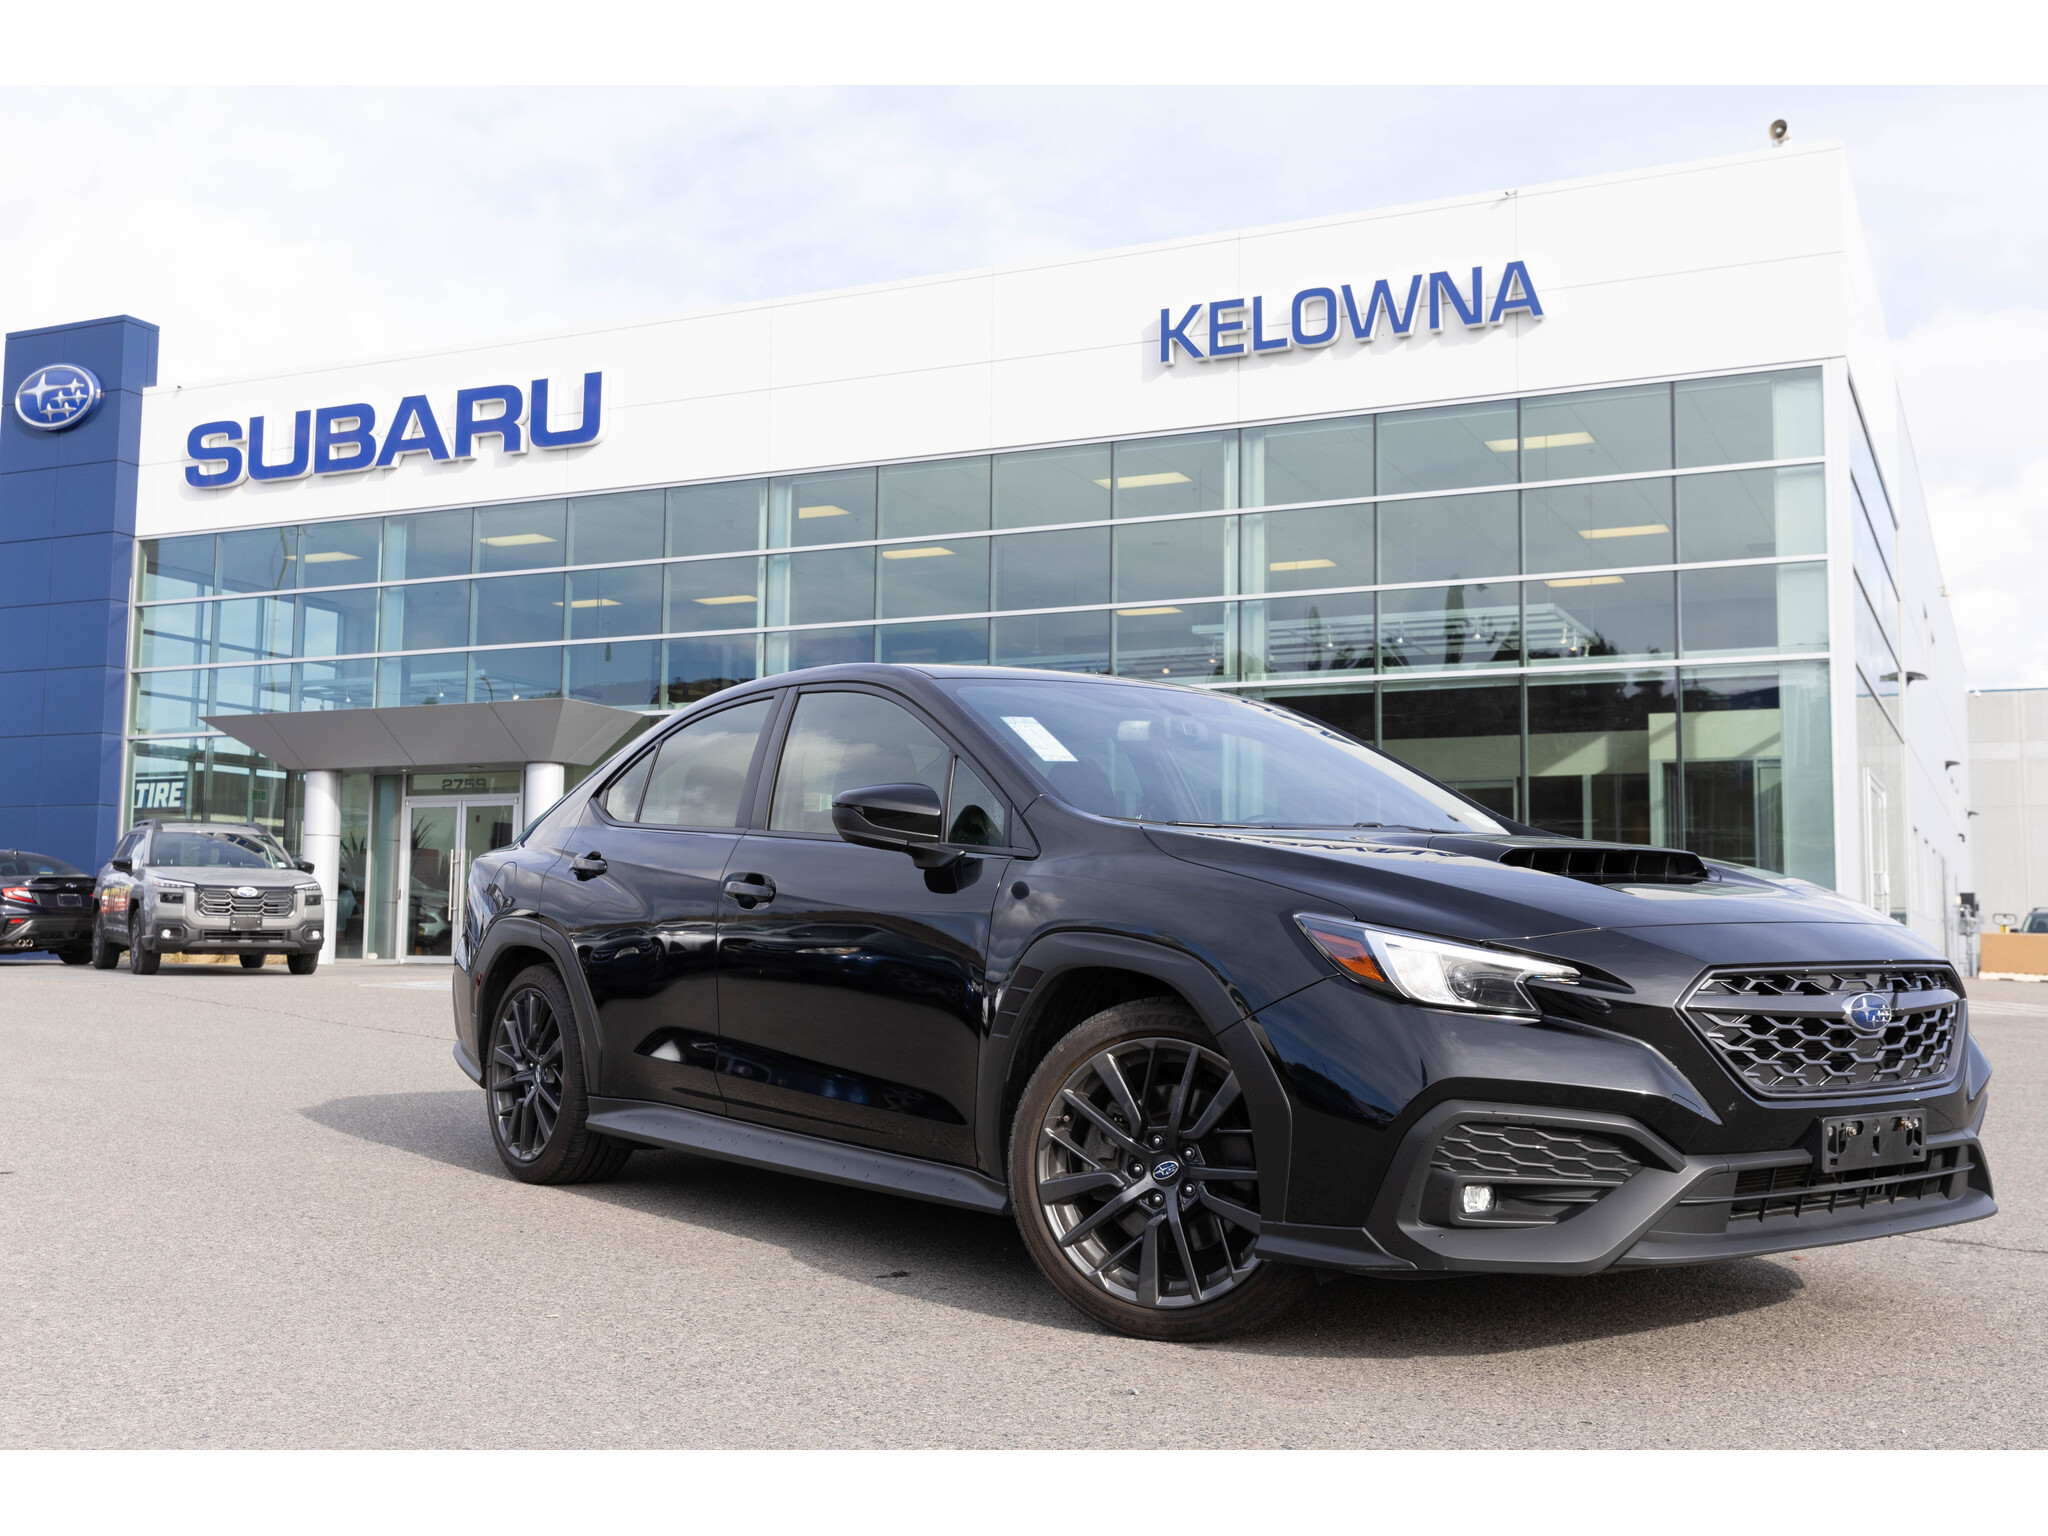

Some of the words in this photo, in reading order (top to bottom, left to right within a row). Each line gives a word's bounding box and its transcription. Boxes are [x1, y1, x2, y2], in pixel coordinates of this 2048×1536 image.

[1160, 260, 1545, 365] KELOWNA
[184, 371, 604, 489] SUBARU
[135, 780, 185, 809] TIRE
[441, 778, 488, 791] 2759
